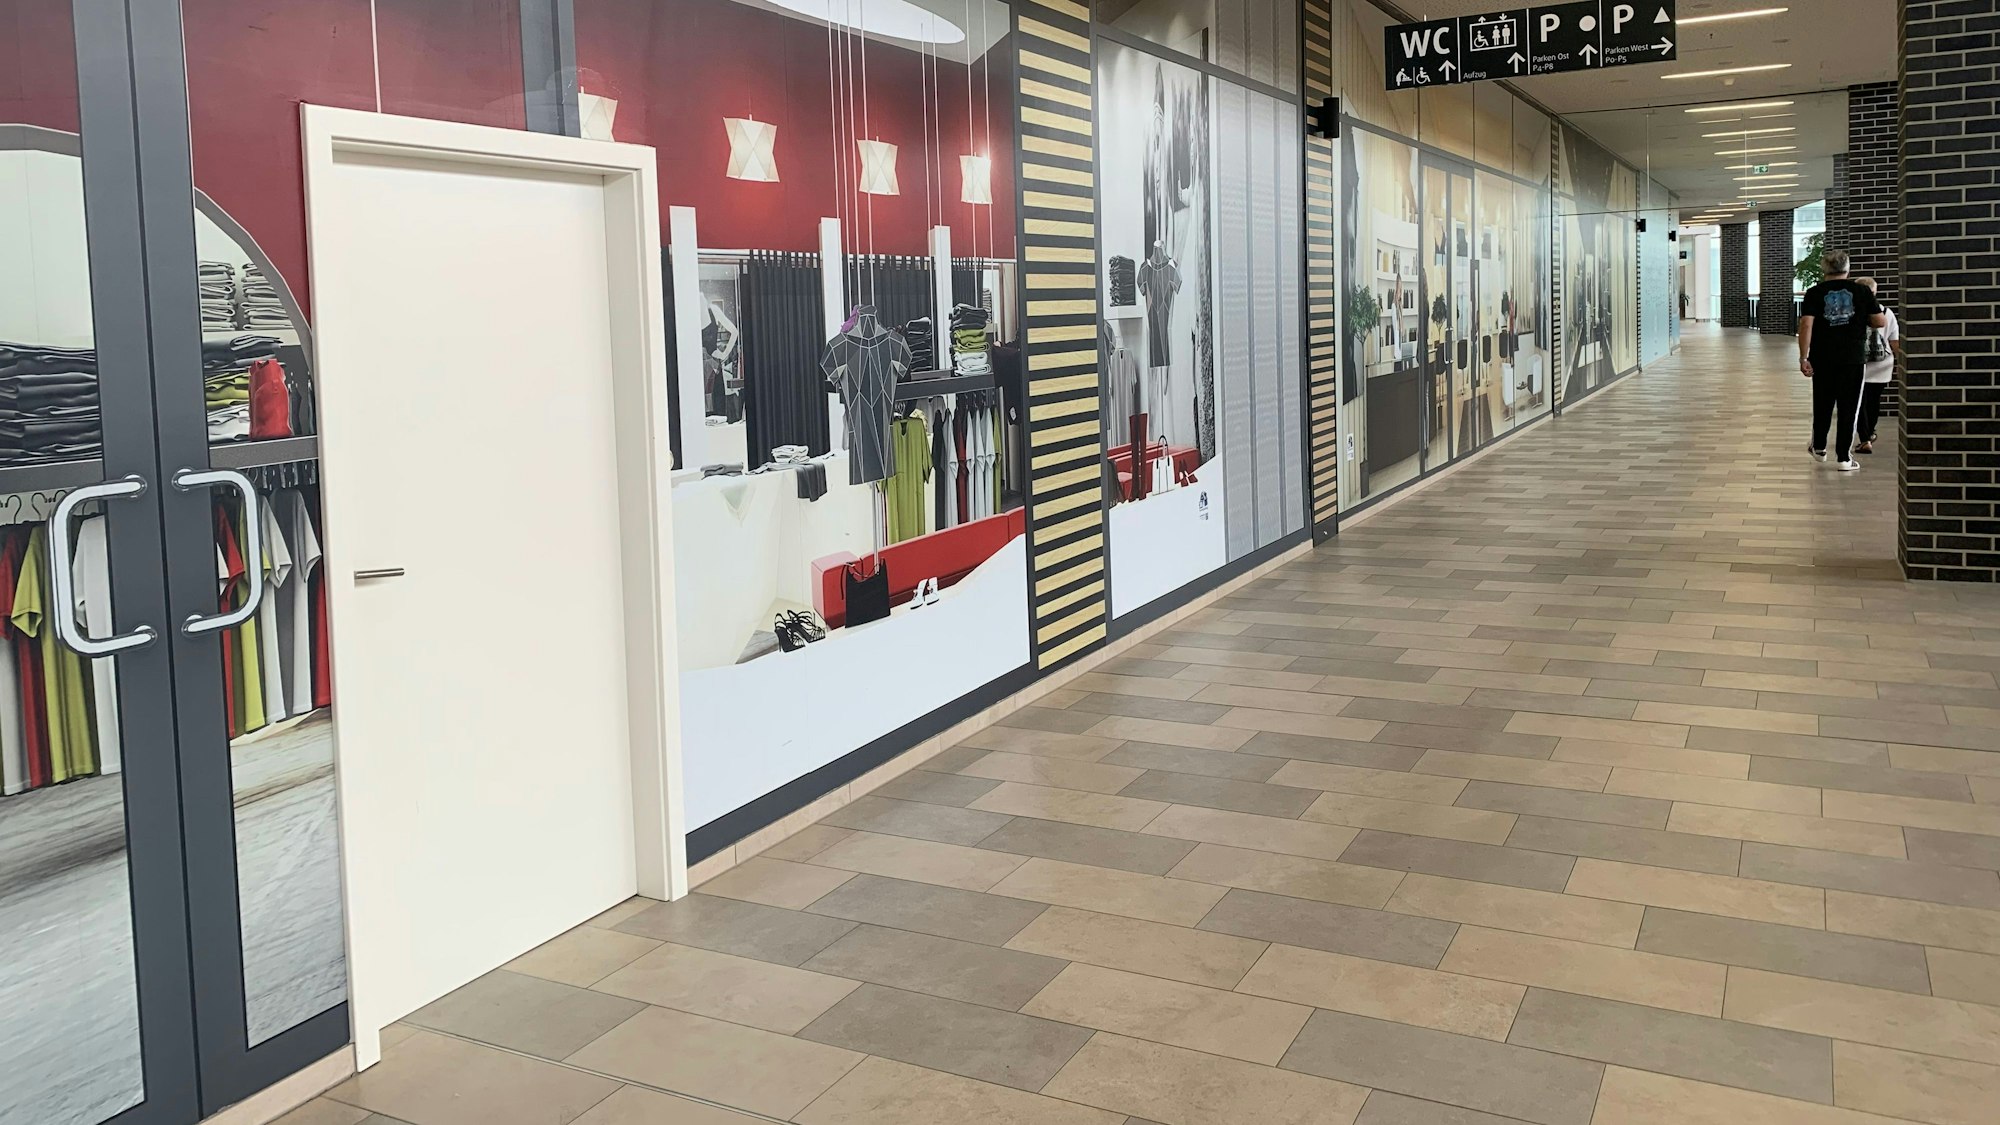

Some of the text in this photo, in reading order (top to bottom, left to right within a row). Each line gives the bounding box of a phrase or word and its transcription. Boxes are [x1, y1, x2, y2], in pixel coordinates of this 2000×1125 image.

[1613, 4, 1634, 34] P
[1540, 13, 1560, 43] P
[1399, 26, 1450, 59] WC
[1605, 44, 1649, 55] Parken West
[1532, 52, 1569, 63] Parken Ost
[1532, 63, 1554, 72] P4-P8
[1463, 70, 1487, 80] Aufzug
